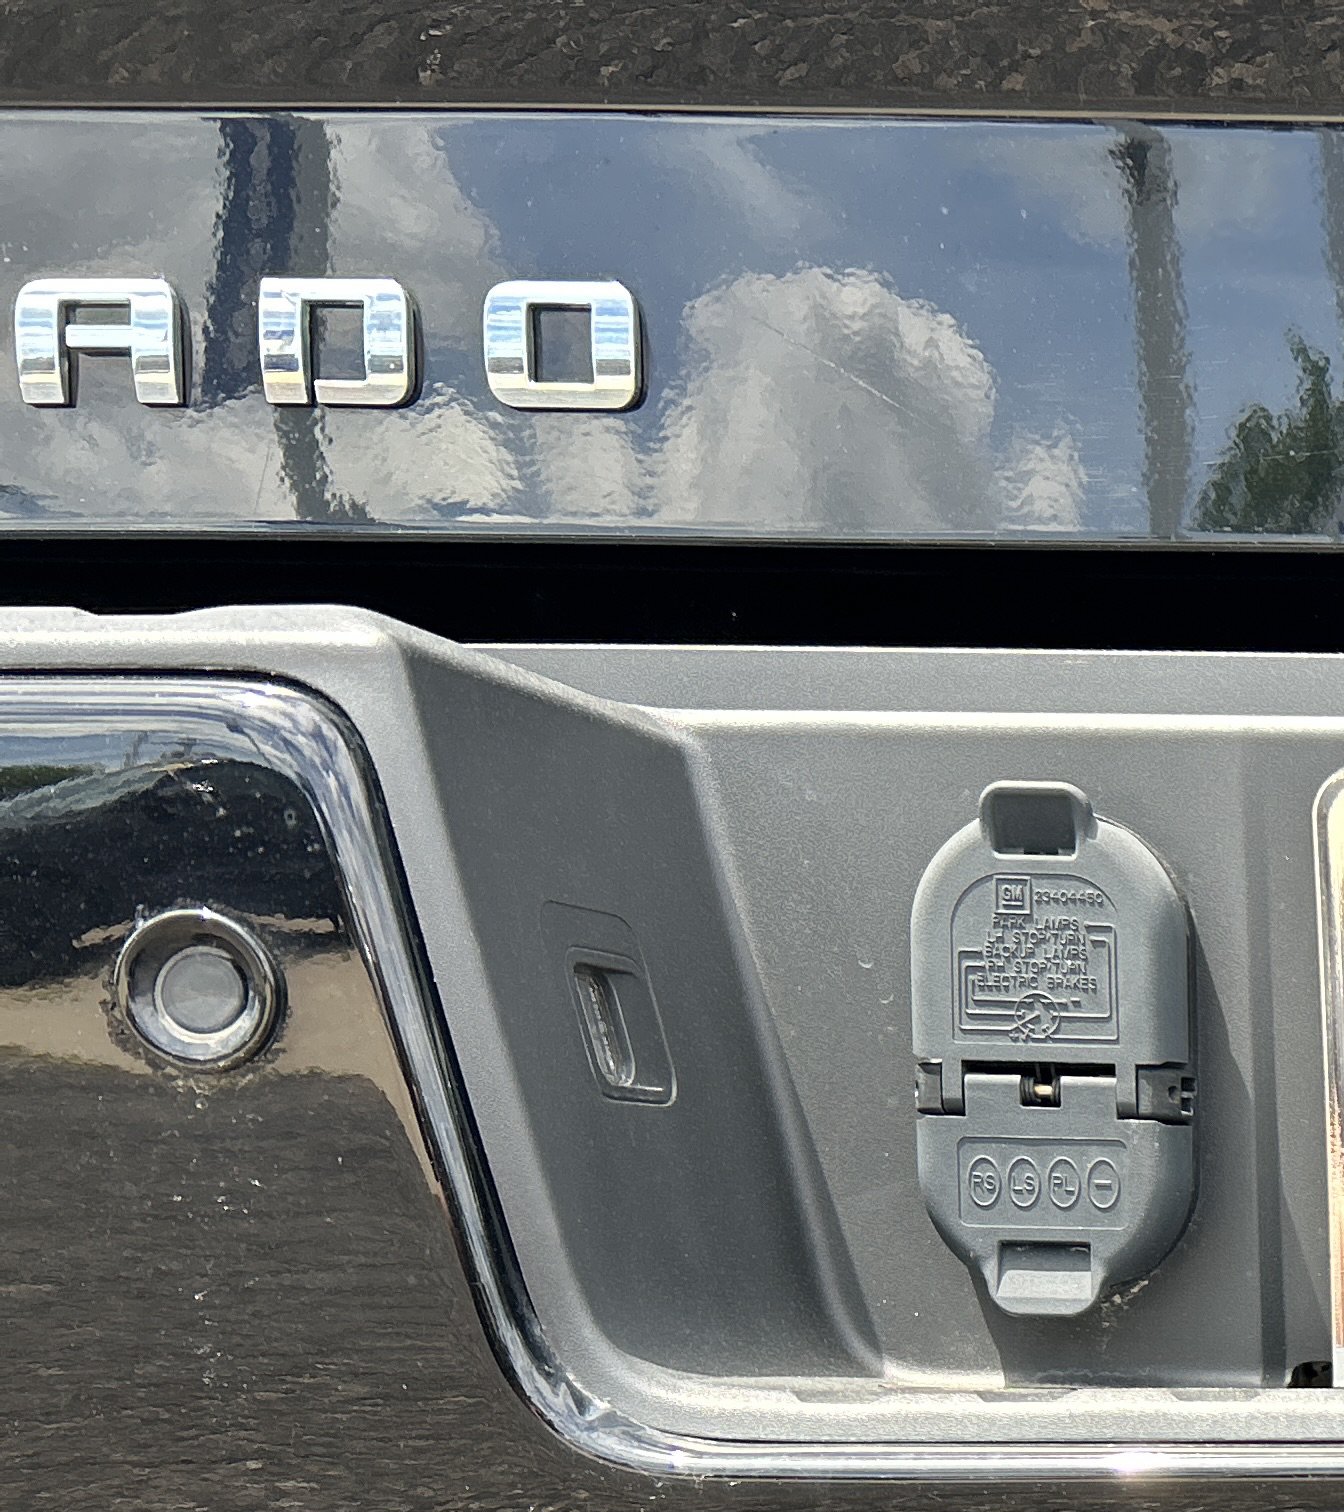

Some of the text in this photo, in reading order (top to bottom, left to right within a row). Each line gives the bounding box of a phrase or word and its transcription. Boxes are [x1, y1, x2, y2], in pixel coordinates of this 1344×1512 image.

[1001, 884, 1023, 901] GM
[992, 914, 1079, 930] PARK LAMPS
[984, 943, 1088, 960] BACKUP LAMPS
[976, 973, 1097, 990] ELECTRIC BRAKES
[972, 1171, 996, 1194] RS
[1012, 1172, 1035, 1193] LS
[1052, 1173, 1075, 1193] PL
